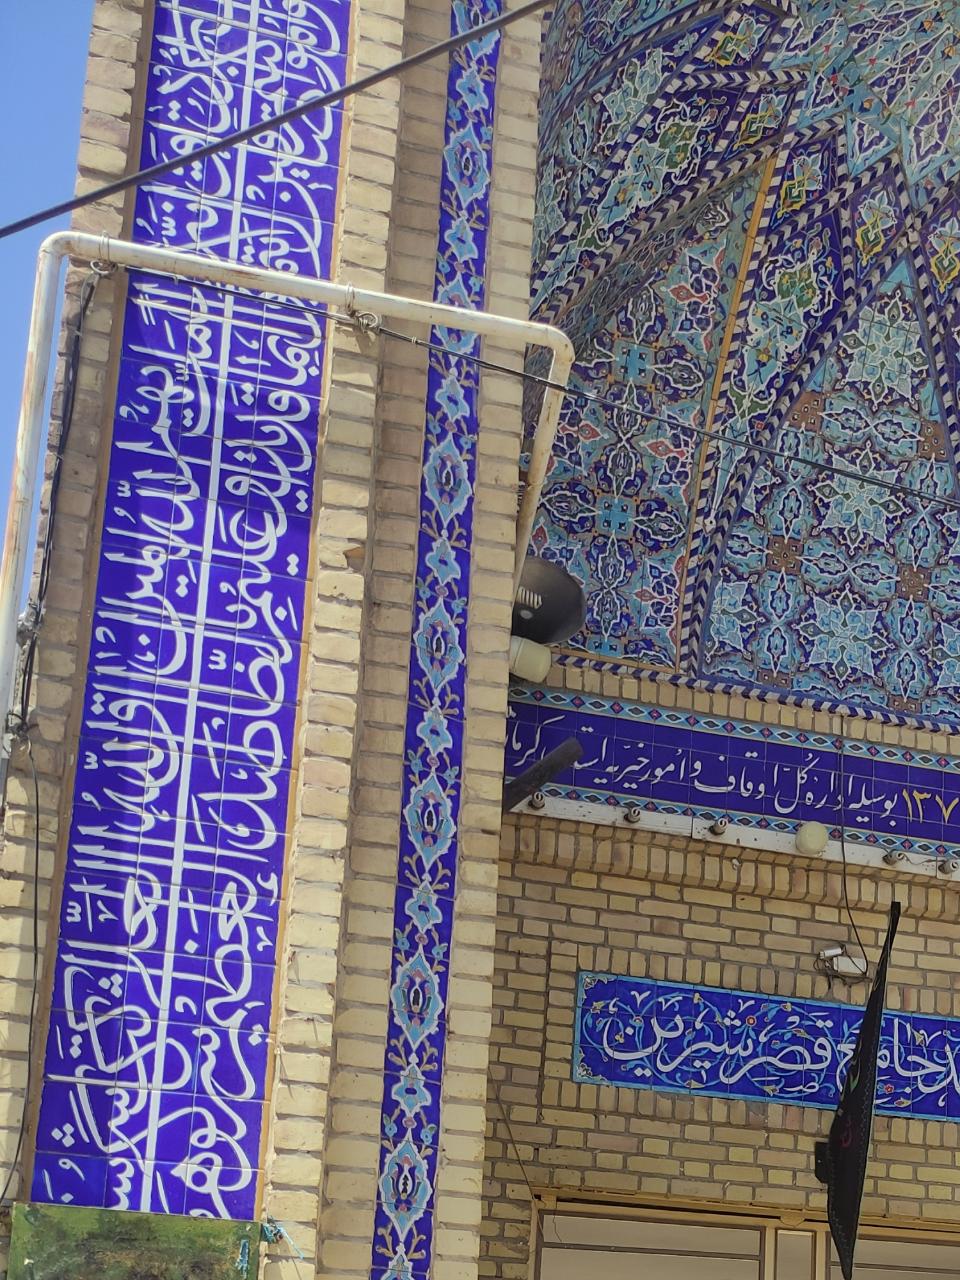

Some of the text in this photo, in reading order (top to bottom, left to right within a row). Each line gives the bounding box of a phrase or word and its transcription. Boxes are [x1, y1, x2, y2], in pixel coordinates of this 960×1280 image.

[603, 1010, 755, 1078] شیرین
[719, 1018, 833, 1085] قصر
[836, 1017, 946, 1095] جامع
